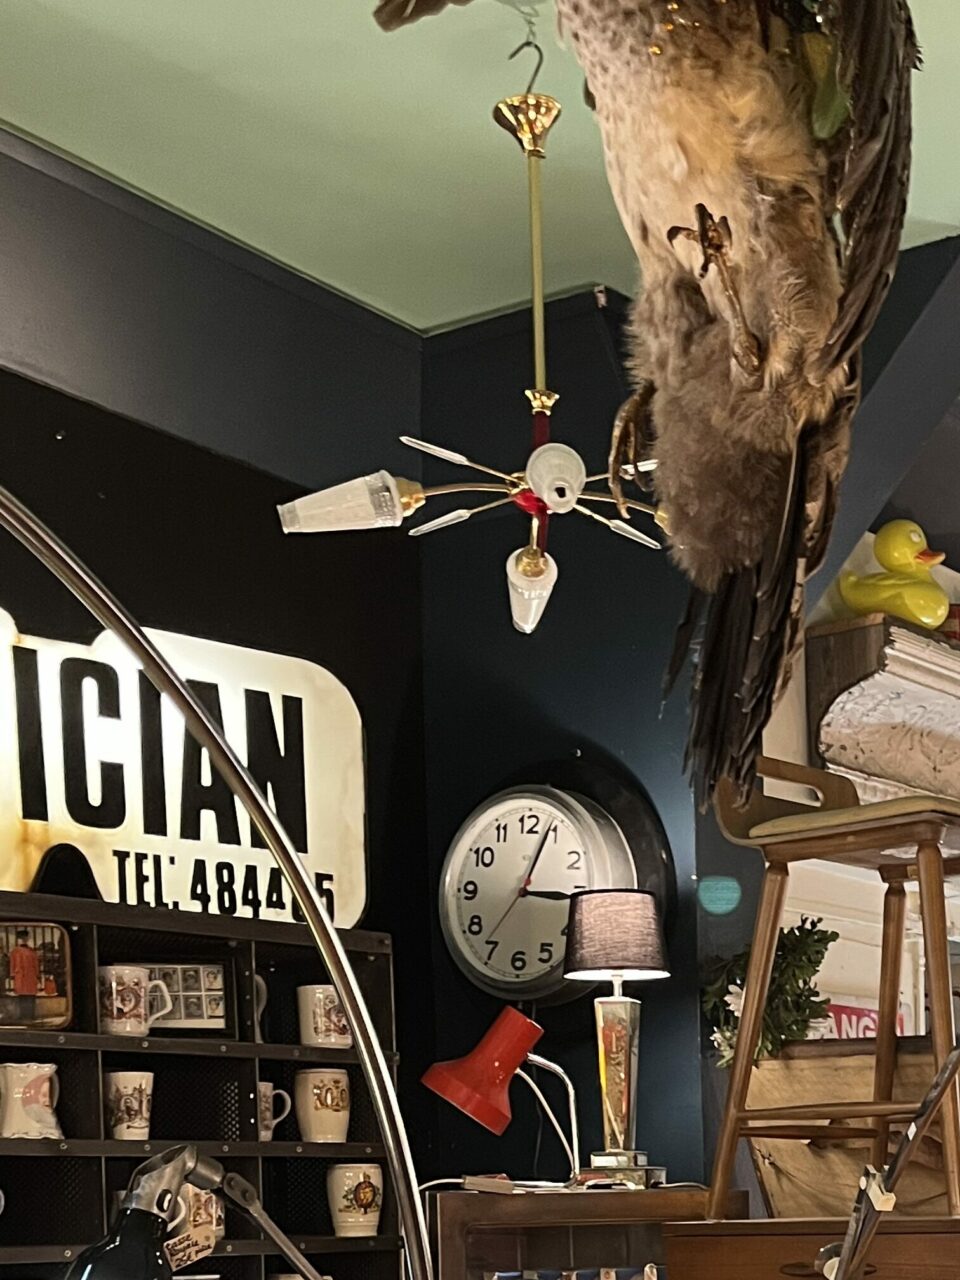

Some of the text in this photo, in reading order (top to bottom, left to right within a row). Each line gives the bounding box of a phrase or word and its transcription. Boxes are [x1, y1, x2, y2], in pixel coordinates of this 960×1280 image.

[496, 822, 508, 843] 11
[518, 814, 540, 834] 12
[473, 846, 494, 867] 10
[567, 850, 581, 870] 2
[190, 858, 335, 924] 48445
[463, 880, 478, 901] 9
[467, 914, 482, 936] 8
[484, 940, 499, 961] 7
[510, 950, 526, 971] 6
[537, 942, 553, 964] 5
